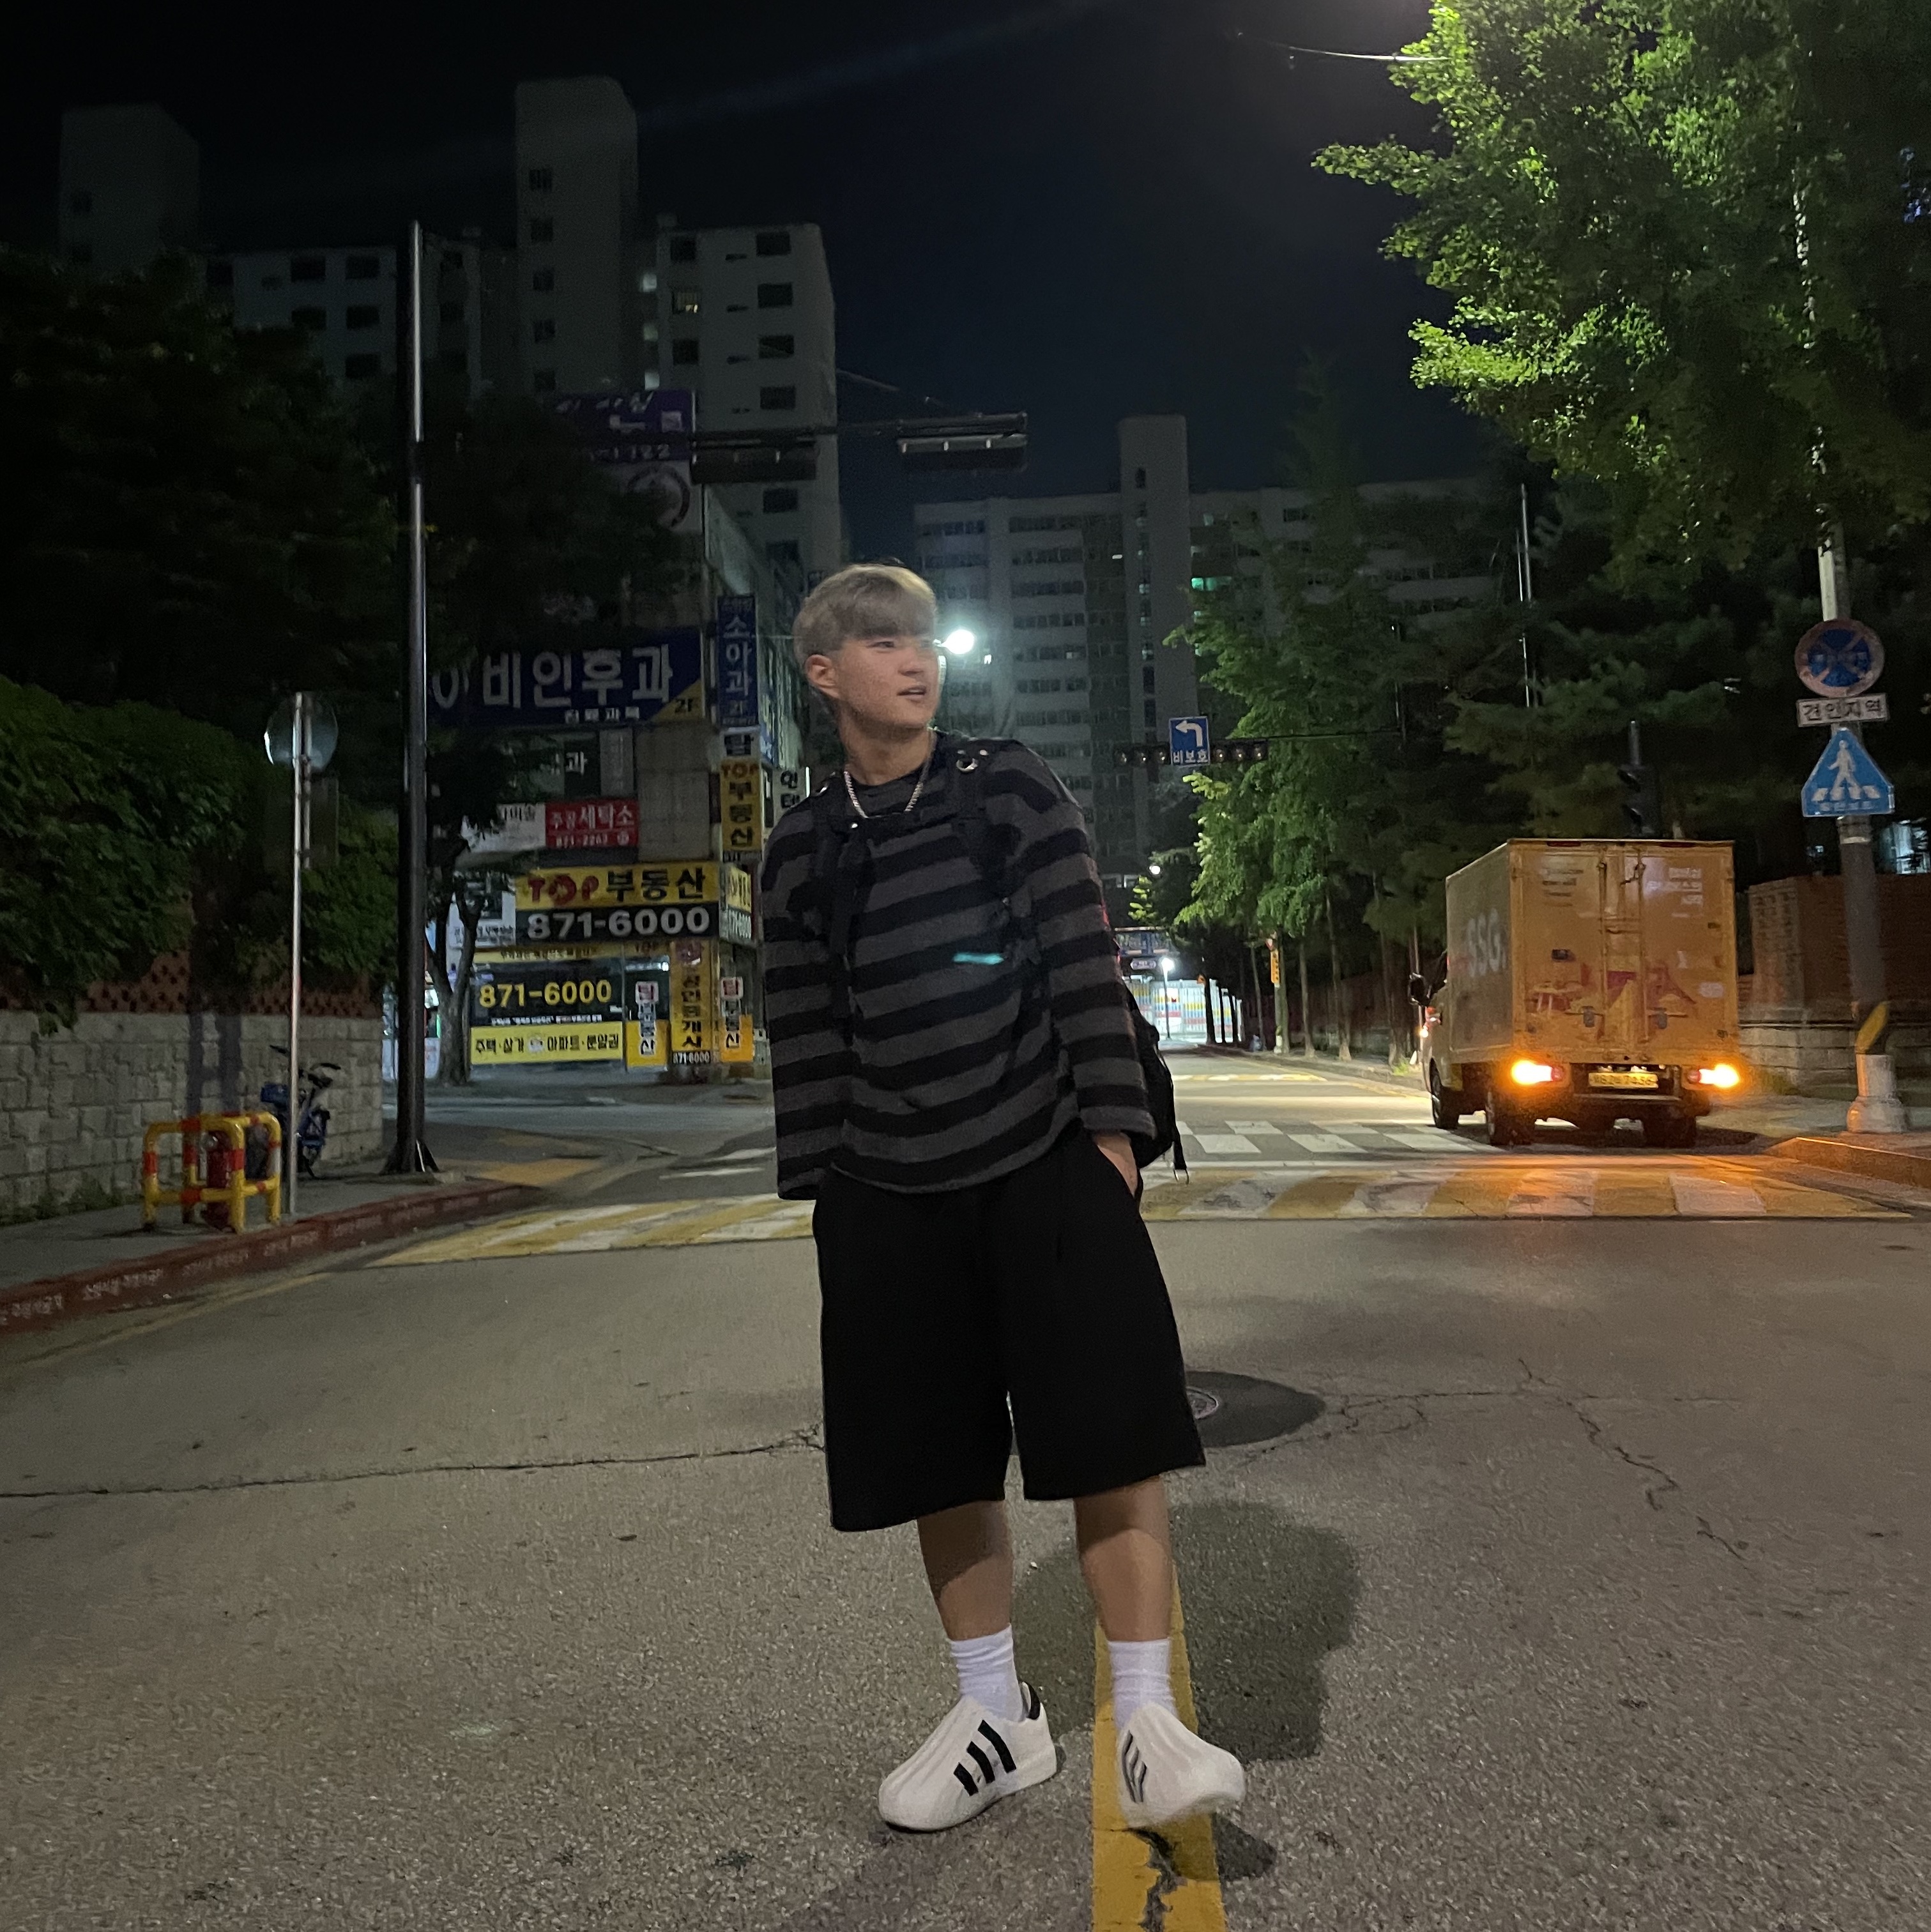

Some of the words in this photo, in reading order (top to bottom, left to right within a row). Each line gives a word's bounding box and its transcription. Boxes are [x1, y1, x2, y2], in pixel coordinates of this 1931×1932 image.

[722, 614, 752, 697] 소아과
[1173, 749, 1209, 764] 비보호
[528, 874, 599, 906] TOP
[607, 867, 706, 902] 부동산
[528, 906, 710, 940] 871-6000
[479, 979, 612, 1008] 871-6000
